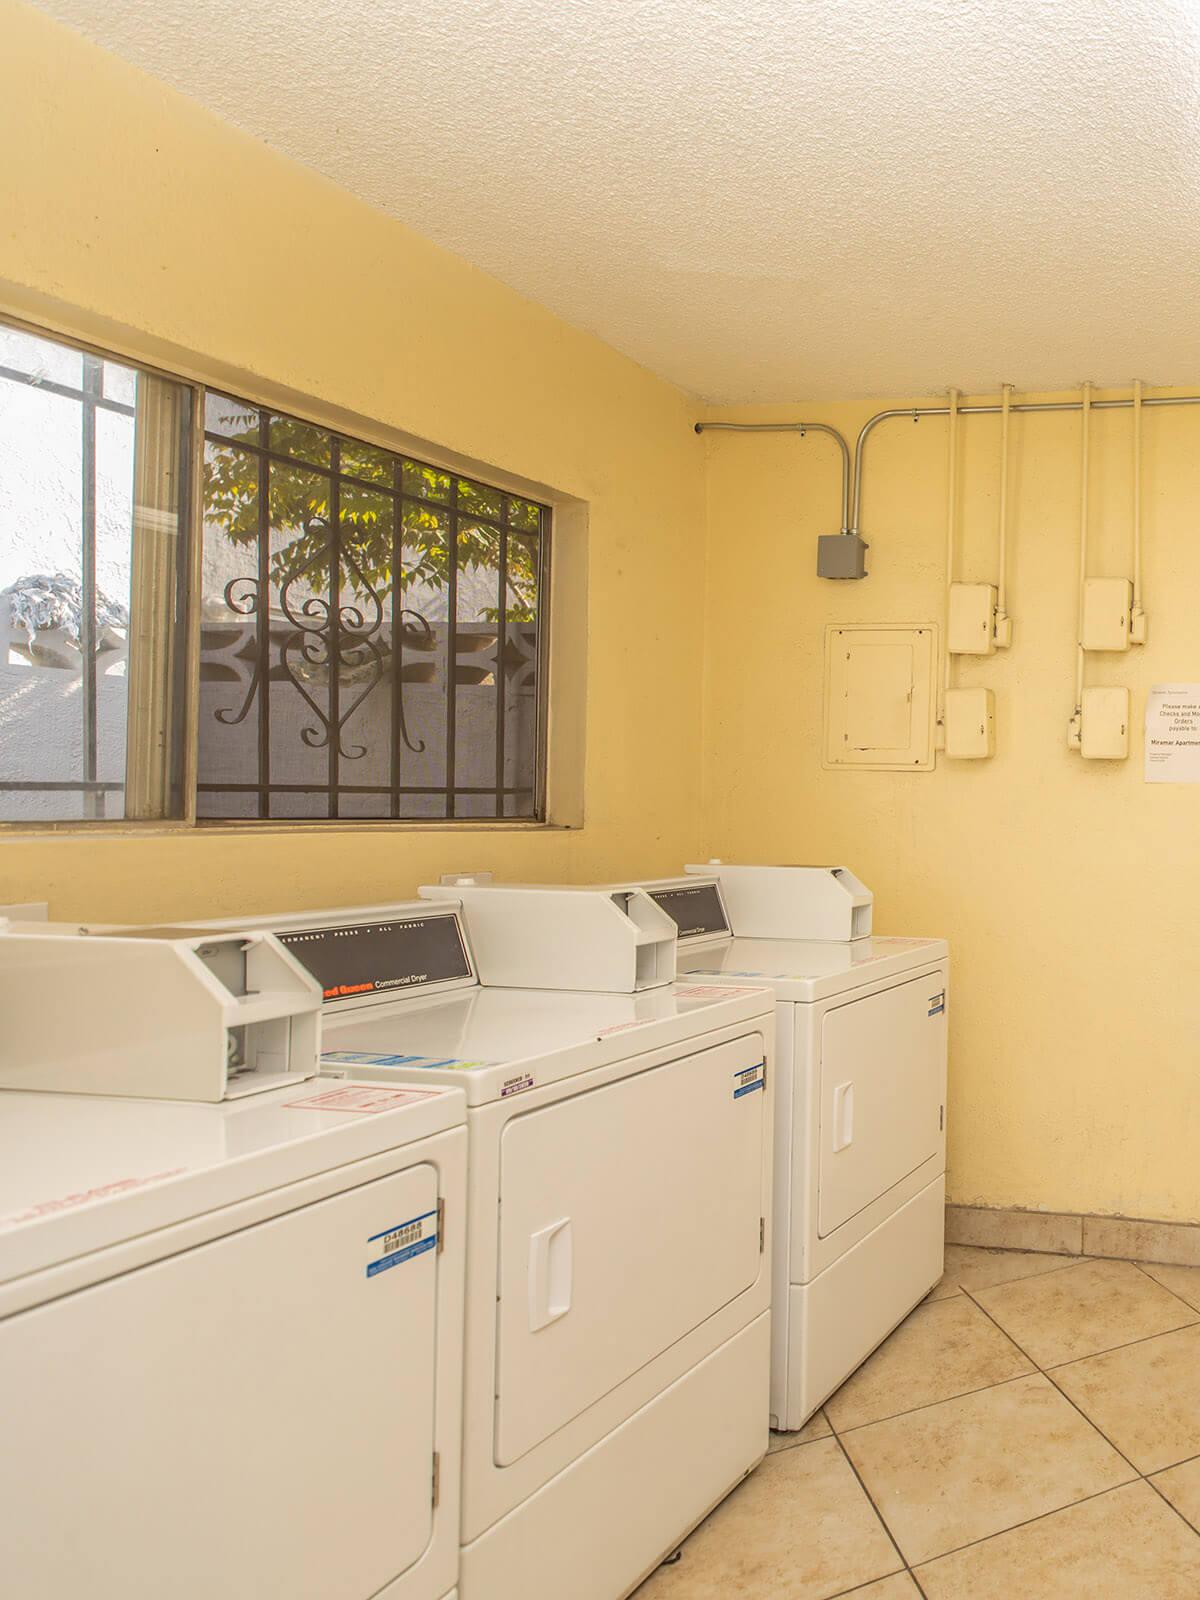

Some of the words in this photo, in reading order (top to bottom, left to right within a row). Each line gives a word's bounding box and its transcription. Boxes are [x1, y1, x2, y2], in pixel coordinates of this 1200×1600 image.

[282, 934, 325, 943] ERMANENT
[324, 986, 338, 996] ed
[340, 982, 373, 994] Queen
[375, 976, 410, 988] Commercial
[411, 974, 427, 982] Dryer
